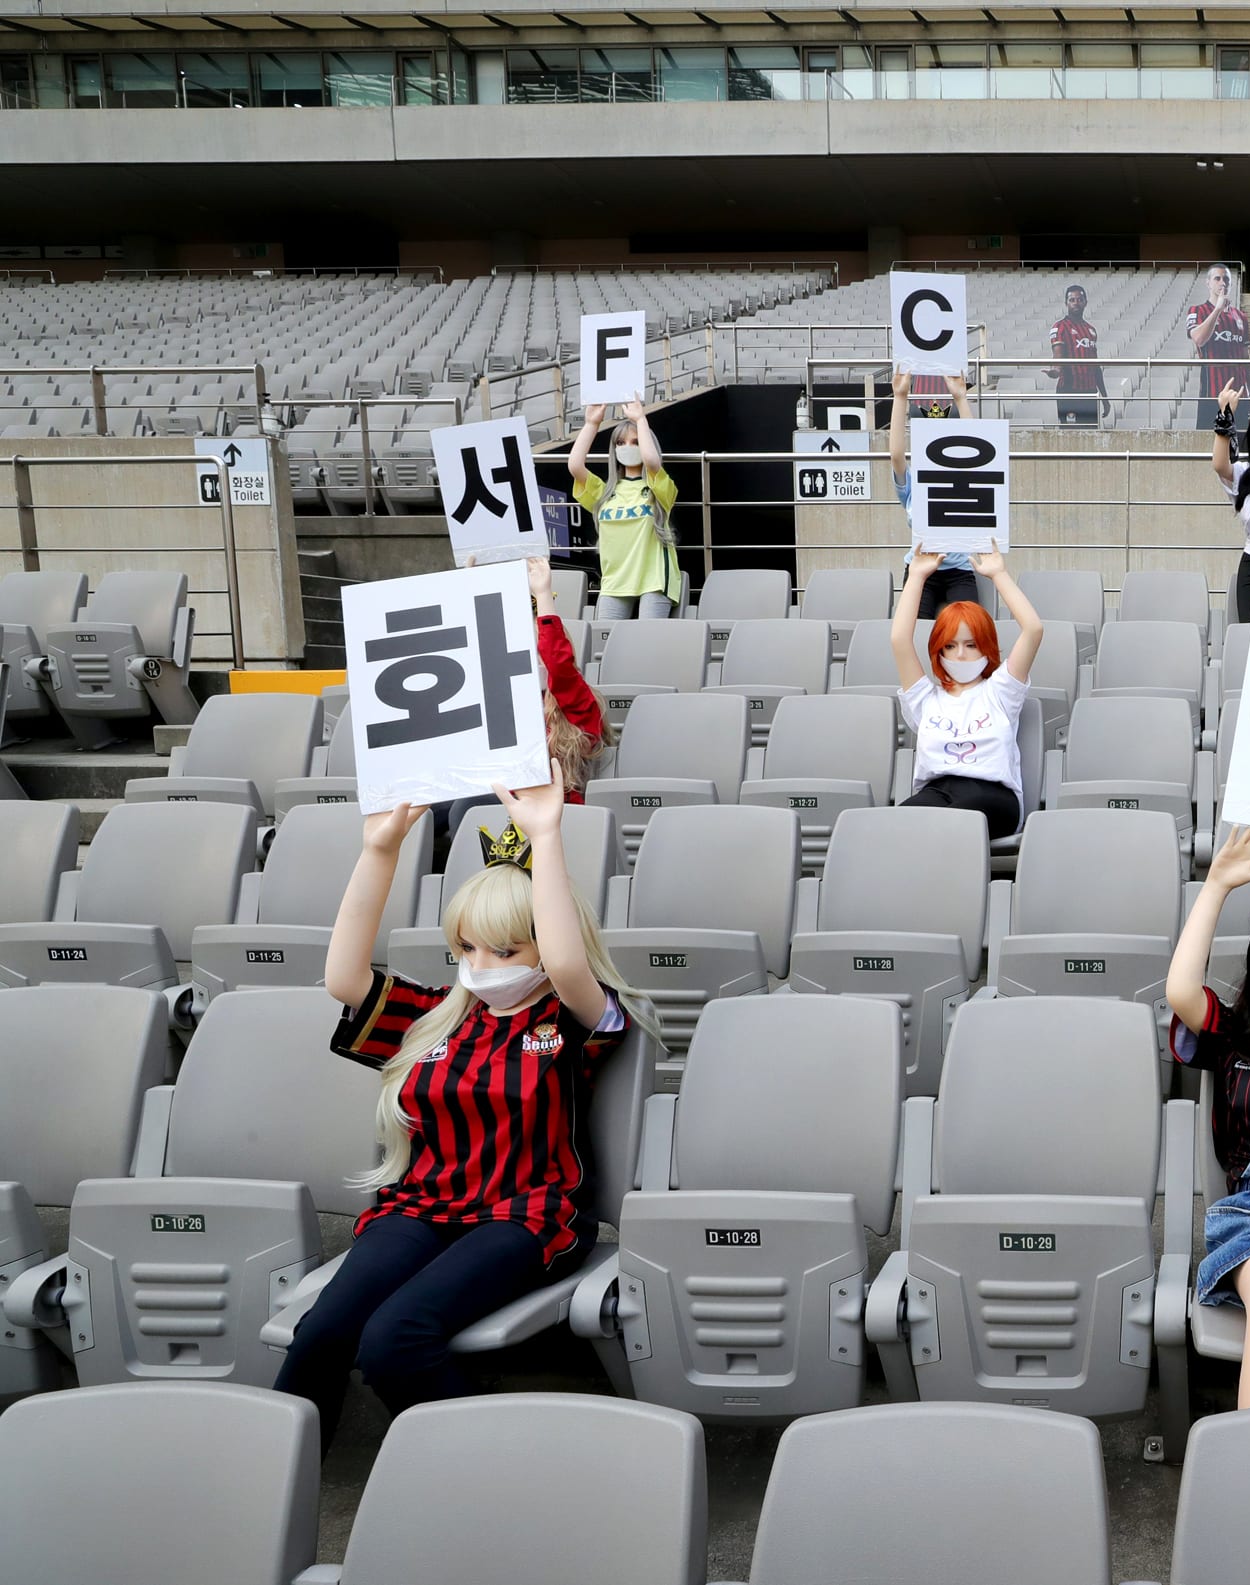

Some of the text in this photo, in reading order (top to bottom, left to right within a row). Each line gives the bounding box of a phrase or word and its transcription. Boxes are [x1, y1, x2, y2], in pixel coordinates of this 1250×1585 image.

[900, 289, 954, 351] C
[596, 326, 633, 381] F
[232, 476, 264, 488] 화장실
[233, 490, 265, 501] Toilet
[451, 435, 534, 533] 서
[832, 471, 865, 483] 화장실
[833, 485, 865, 496] Toilet
[917, 435, 1005, 528] 울
[364, 591, 532, 750] 화
